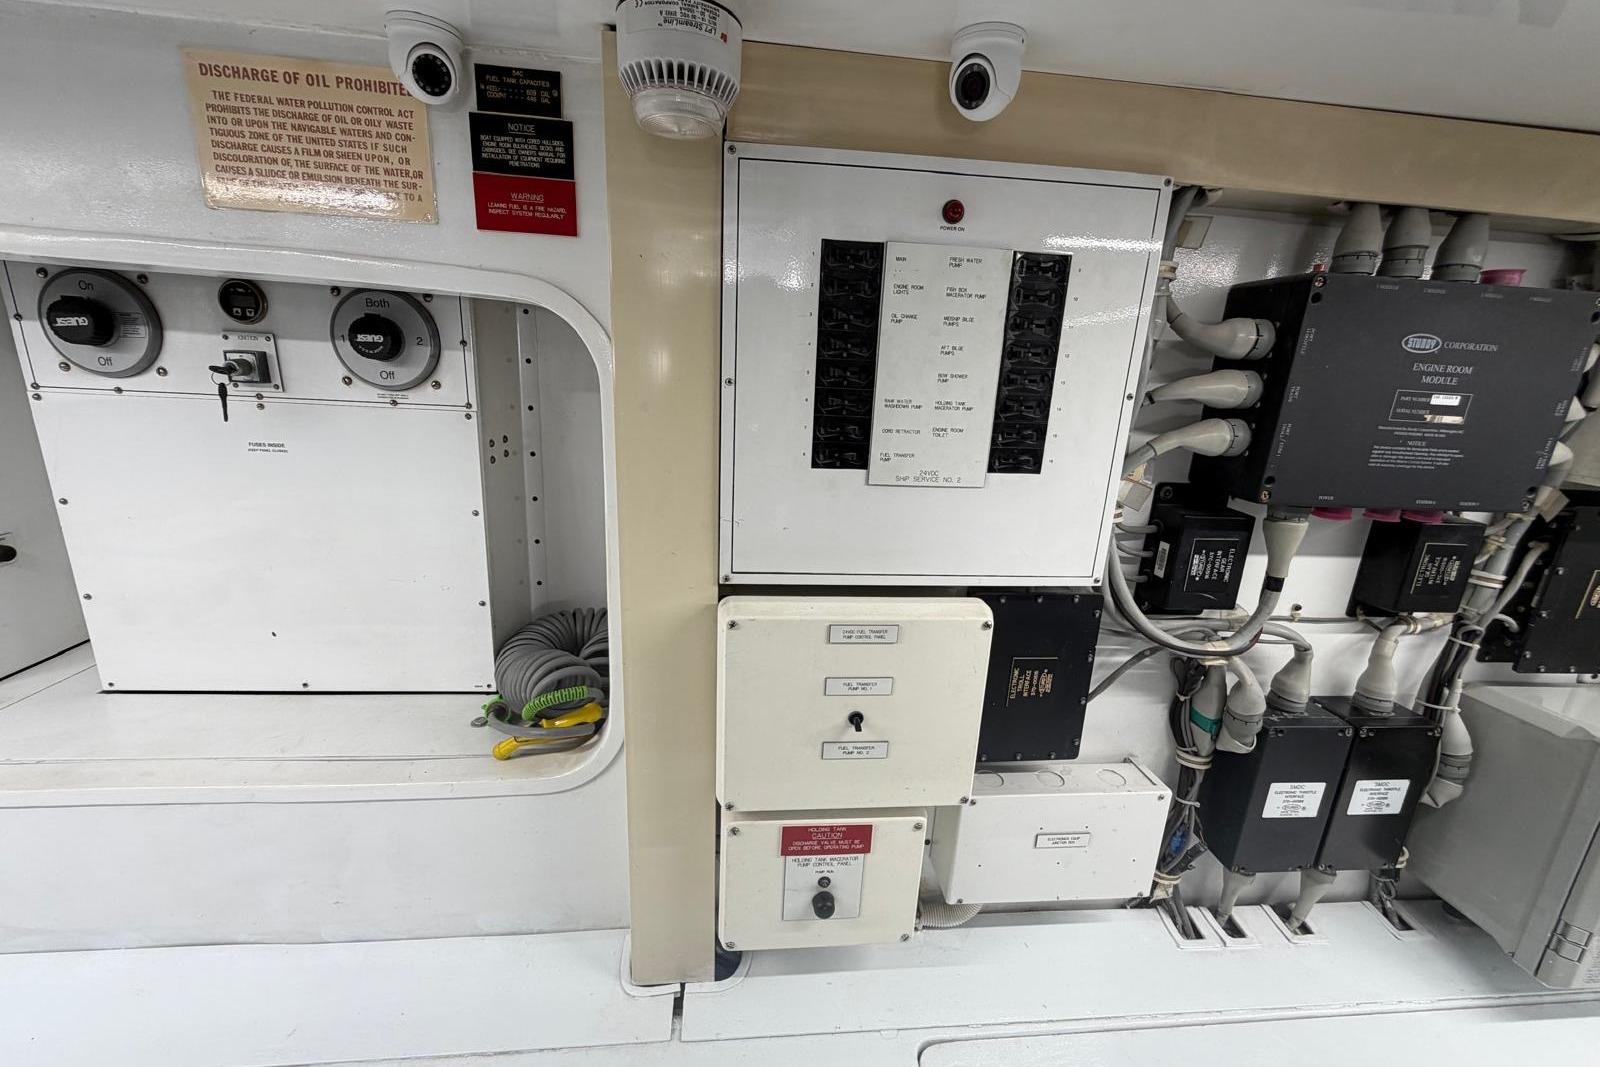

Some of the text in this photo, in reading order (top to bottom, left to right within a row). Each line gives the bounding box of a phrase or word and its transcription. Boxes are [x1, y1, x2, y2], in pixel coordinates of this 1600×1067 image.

[199, 63, 279, 82] DISCHARGE
[283, 72, 300, 85] OF
[306, 74, 330, 88] OIL
[212, 90, 414, 119] THE FEDERAL WATER POLLUTION CONTROL ACT
[206, 103, 414, 130] PROHIBITS THE DISCHARGE OF OIL OR OILY WASTE
[207, 115, 416, 142] INTO OR UPON THE NAVIGABLE WATERS AND CON-
[508, 123, 535, 133] NOTICE
[210, 128, 408, 154] TIGUOUS ZONE OF THE UNITED STATES IF SUCH
[211, 140, 410, 165] DISCHARGE CAUSES A FILM OR SHEEN UPON, OR
[213, 152, 278, 165] DISCOLORATION
[295, 159, 310, 168] THE
[313, 161, 349, 172] SURFACE
[351, 165, 361, 173] OF
[365, 166, 380, 175] THE
[215, 164, 246, 174] CAUSES
[255, 168, 285, 178] SLUDGE
[289, 171, 300, 180] OR
[301, 172, 343, 183] EMULSION
[345, 176, 380, 186] BENEATH
[384, 180, 399, 189] THE
[402, 181, 422, 190] SUR-
[405, 193, 415, 202] TO
[418, 194, 422, 202] A
[511, 192, 544, 202] WARNING
[78, 280, 94, 290] On
[365, 298, 390, 309] Both
[52, 317, 88, 327] GUEST
[340, 335, 345, 343] 1
[356, 334, 383, 343] GUEST
[416, 337, 423, 346] 2
[1444, 341, 1498, 352] CORPORATION
[98, 356, 113, 366] Off
[1413, 363, 1474, 374] ENGINE ROOM
[380, 370, 395, 380] Off
[1421, 376, 1459, 385] MODULE
[1211, 550, 1222, 580] INTERFACE
[1223, 548, 1236, 582] ELECTRONIC
[1416, 554, 1430, 586] ELECTRONIC
[1010, 668, 1020, 699] ELECTRONIC
[1023, 670, 1031, 697] INTERFACE
